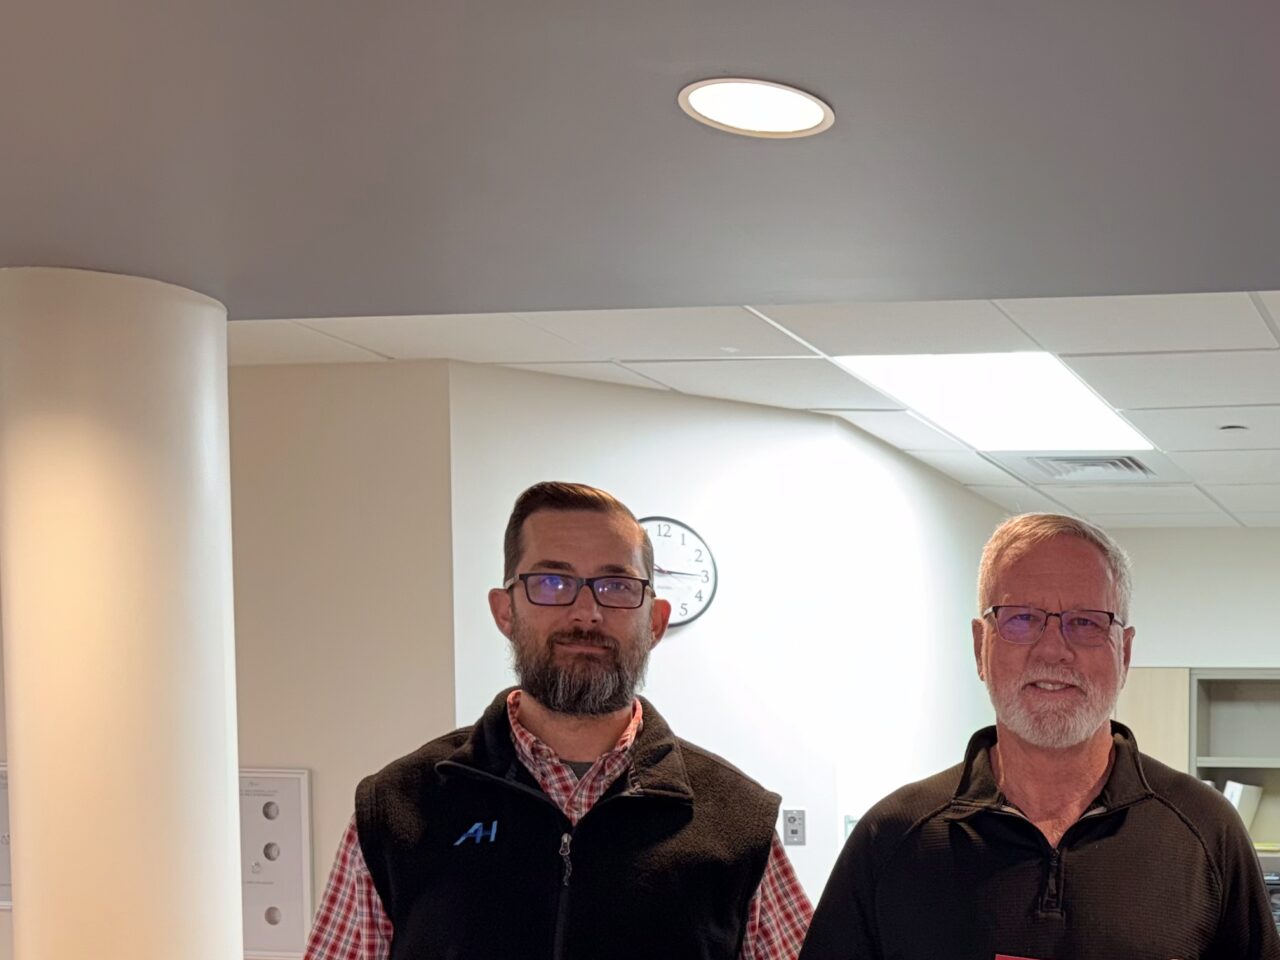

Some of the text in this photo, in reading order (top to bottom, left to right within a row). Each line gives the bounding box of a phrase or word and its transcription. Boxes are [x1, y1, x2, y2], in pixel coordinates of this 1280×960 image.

[657, 523, 672, 537] 12
[681, 533, 686, 545] 1
[694, 549, 703, 562] 2
[701, 570, 710, 583] 3
[694, 589, 703, 601] 4
[679, 603, 688, 616] 5
